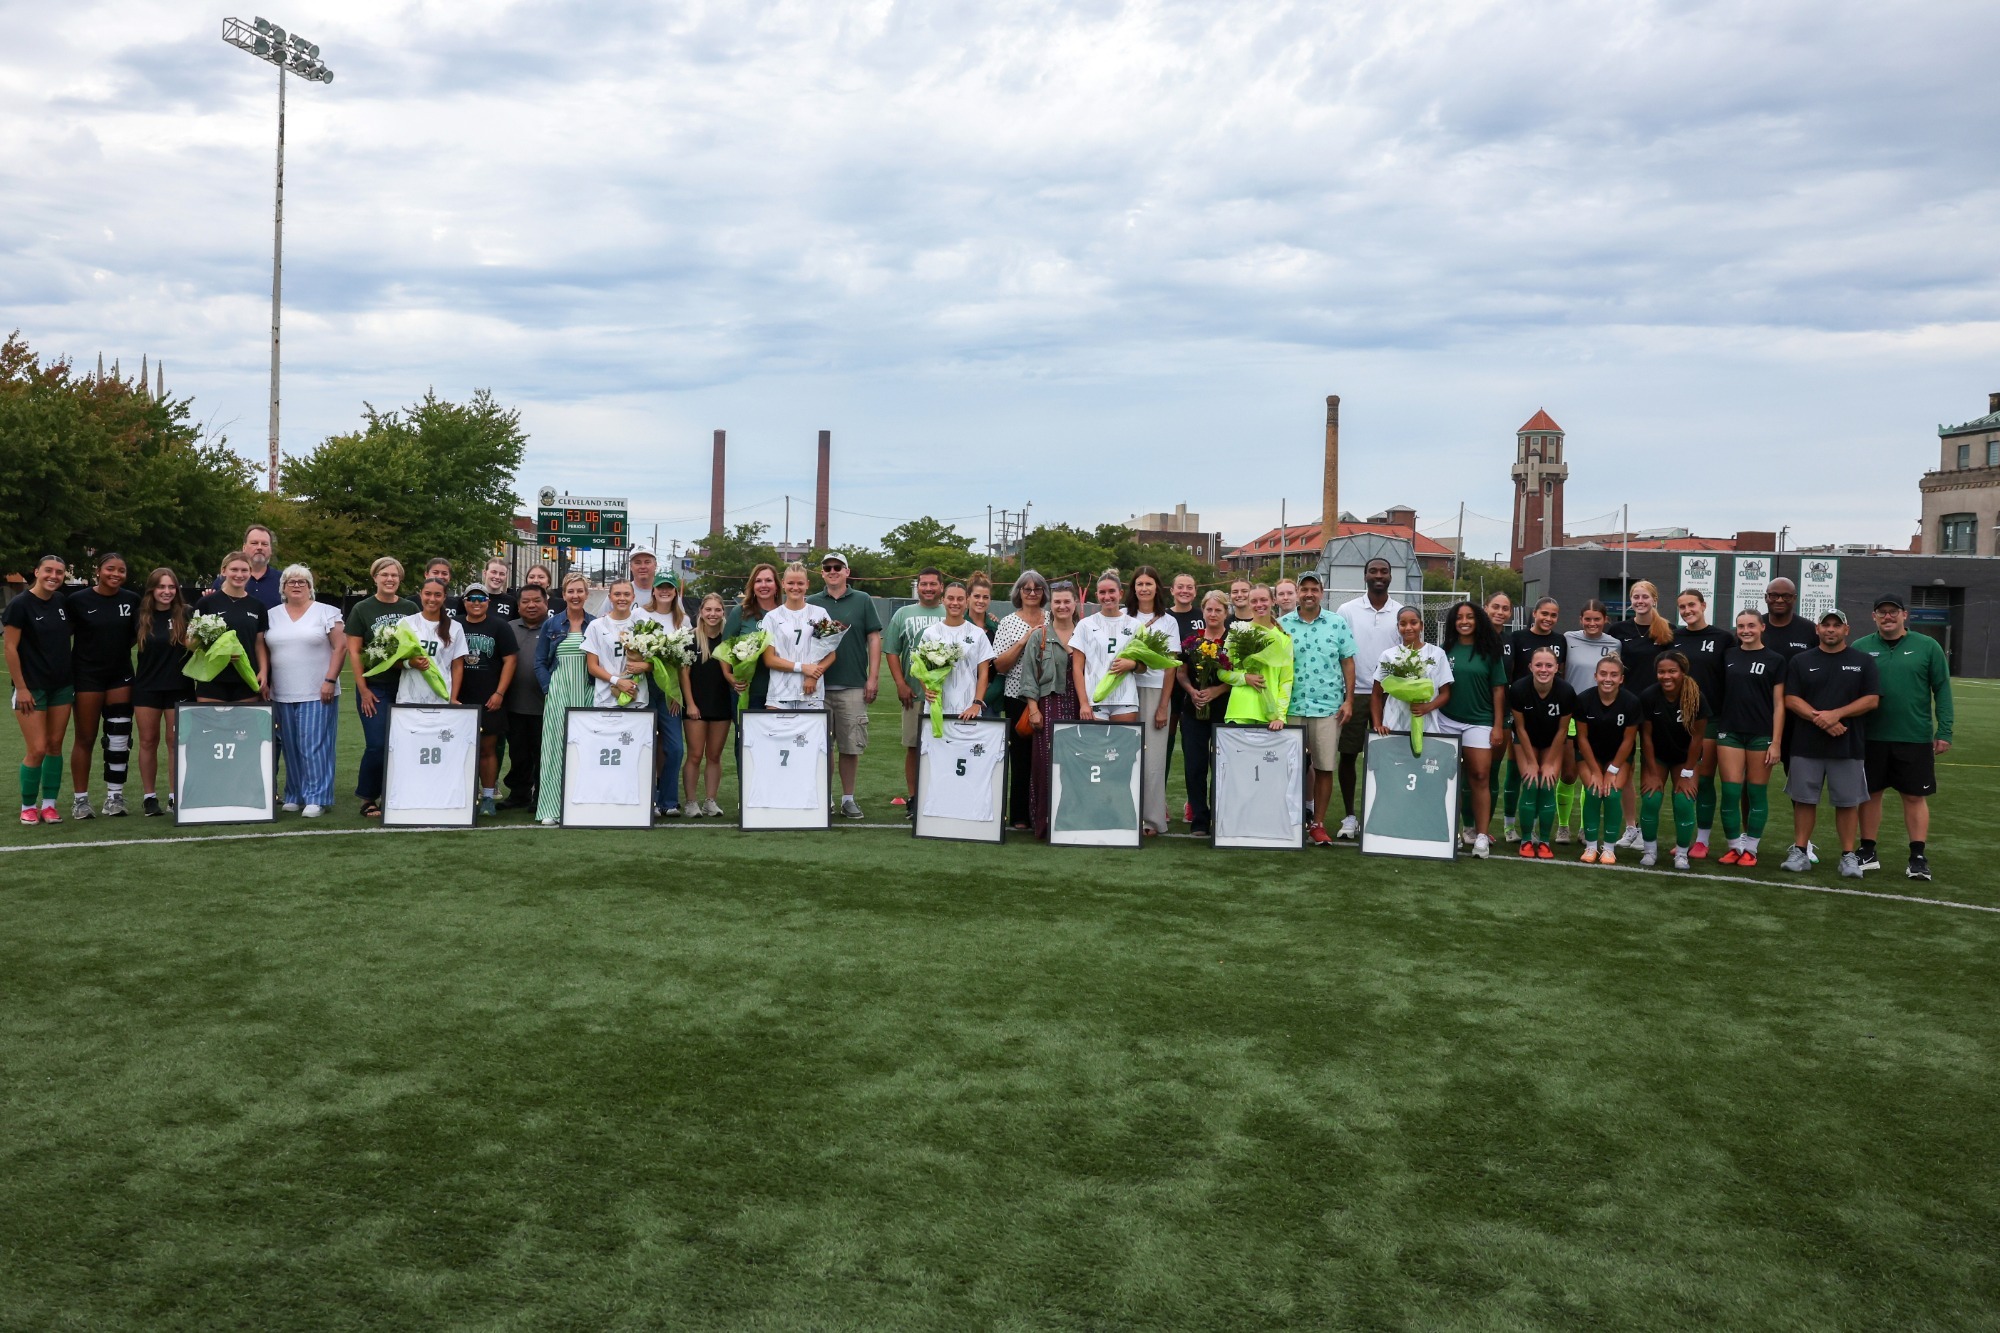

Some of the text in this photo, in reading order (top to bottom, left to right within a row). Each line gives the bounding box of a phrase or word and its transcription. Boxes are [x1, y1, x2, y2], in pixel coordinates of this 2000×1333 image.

[558, 499, 625, 508] CLEVELAND STATE
[567, 510, 599, 523] 53 06
[551, 520, 558, 531] 0
[614, 522, 621, 533] 0
[550, 535, 556, 545] 0
[614, 537, 621, 547] 0
[58, 608, 66, 621] 9
[118, 603, 131, 617] 12
[497, 603, 510, 615] 25
[1190, 619, 1205, 630] 30
[793, 629, 802, 646] 7
[420, 639, 439, 657] 28
[1107, 637, 1117, 654] 2
[1700, 639, 1715, 653] 14
[1749, 661, 1766, 675] 10
[1548, 703, 1561, 716] 21
[1616, 713, 1625, 726] 8
[213, 743, 236, 760] 37
[420, 747, 442, 765] 28
[599, 748, 622, 766] 22
[779, 749, 790, 767] 7
[955, 758, 967, 777] 5
[1090, 765, 1101, 783] 2
[1254, 764, 1260, 782] 1
[1406, 773, 1417, 791] 3
